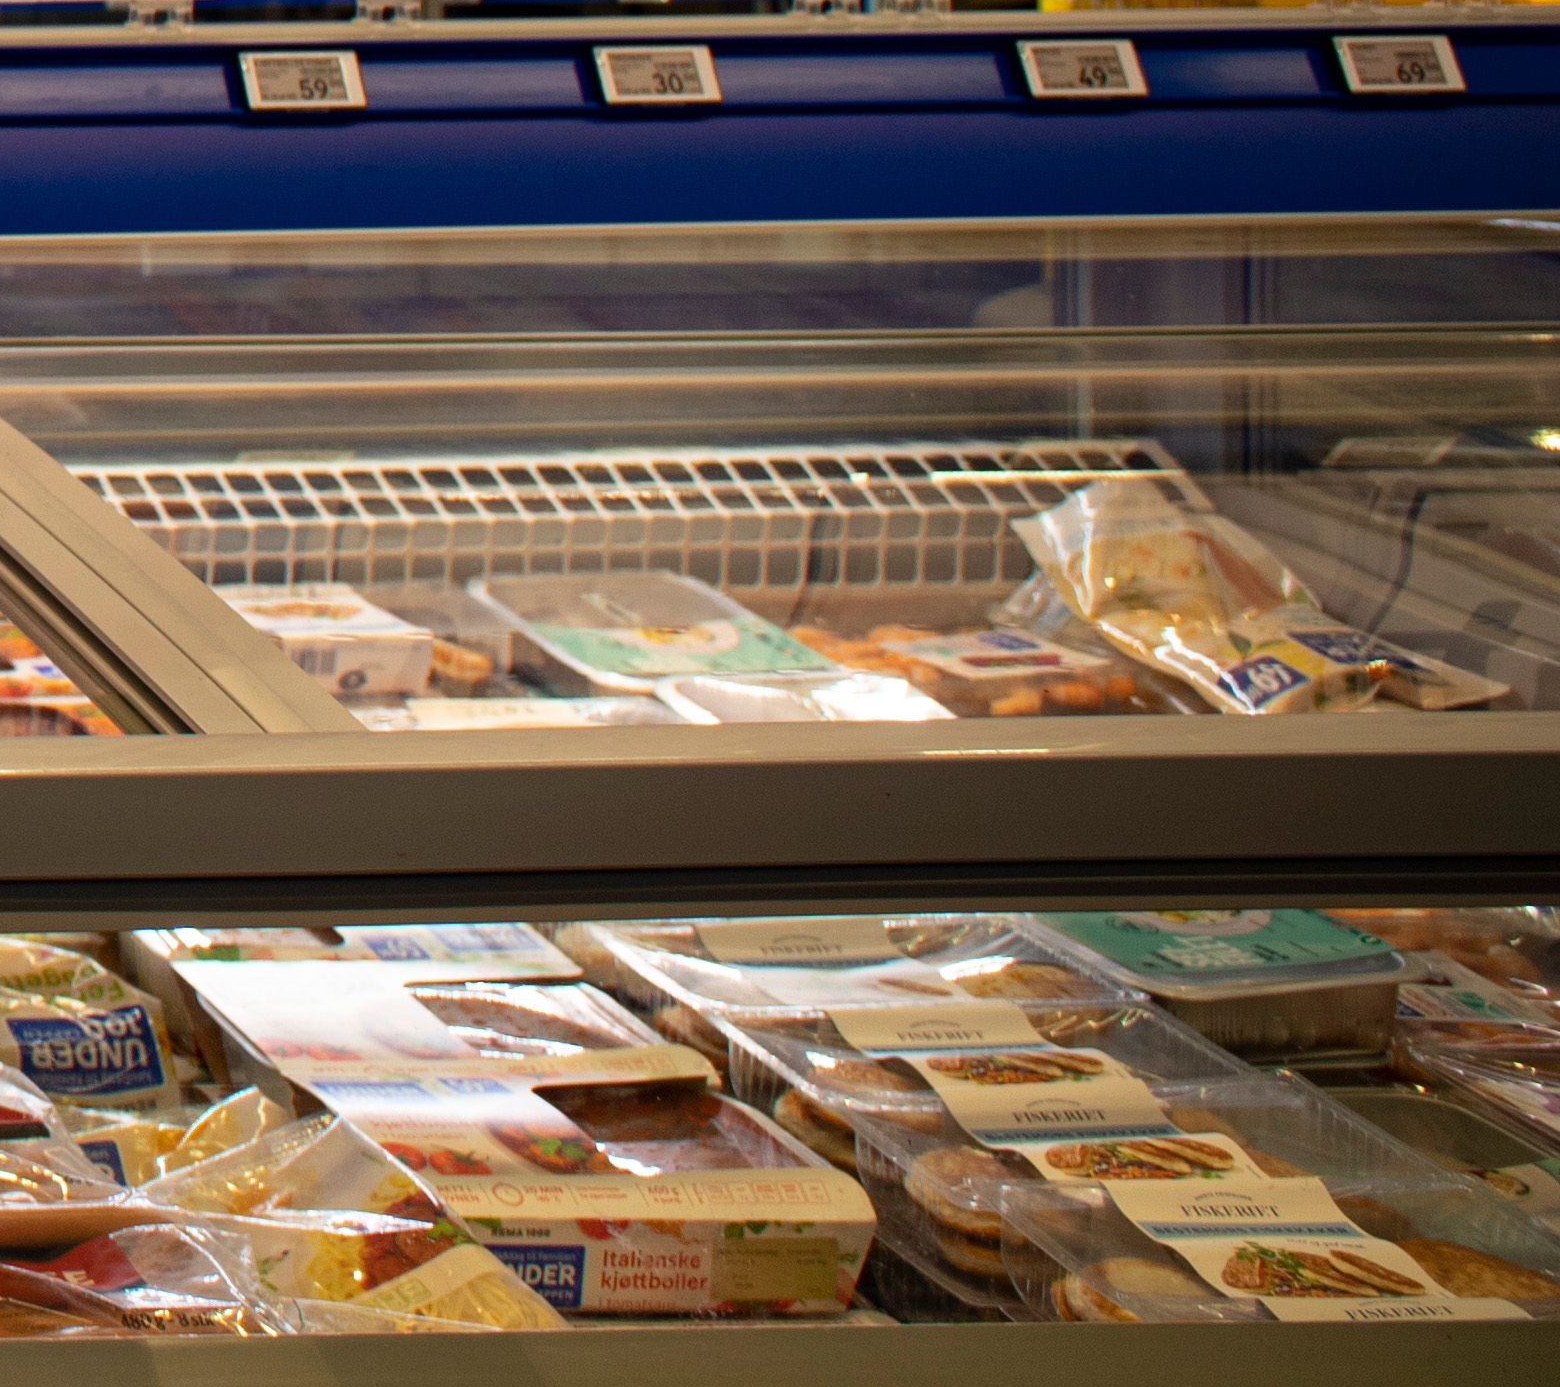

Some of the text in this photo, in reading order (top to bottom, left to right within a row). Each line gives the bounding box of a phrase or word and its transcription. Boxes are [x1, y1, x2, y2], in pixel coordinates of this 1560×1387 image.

[652, 73, 683, 92] 30
[1079, 67, 1107, 87] 49
[1396, 62, 1425, 84] 69
[300, 80, 327, 100] 59
[1181, 1202, 1281, 1219] FISKERIET
[602, 1249, 701, 1270] Italienske
[600, 1270, 708, 1294] kjøttboller
